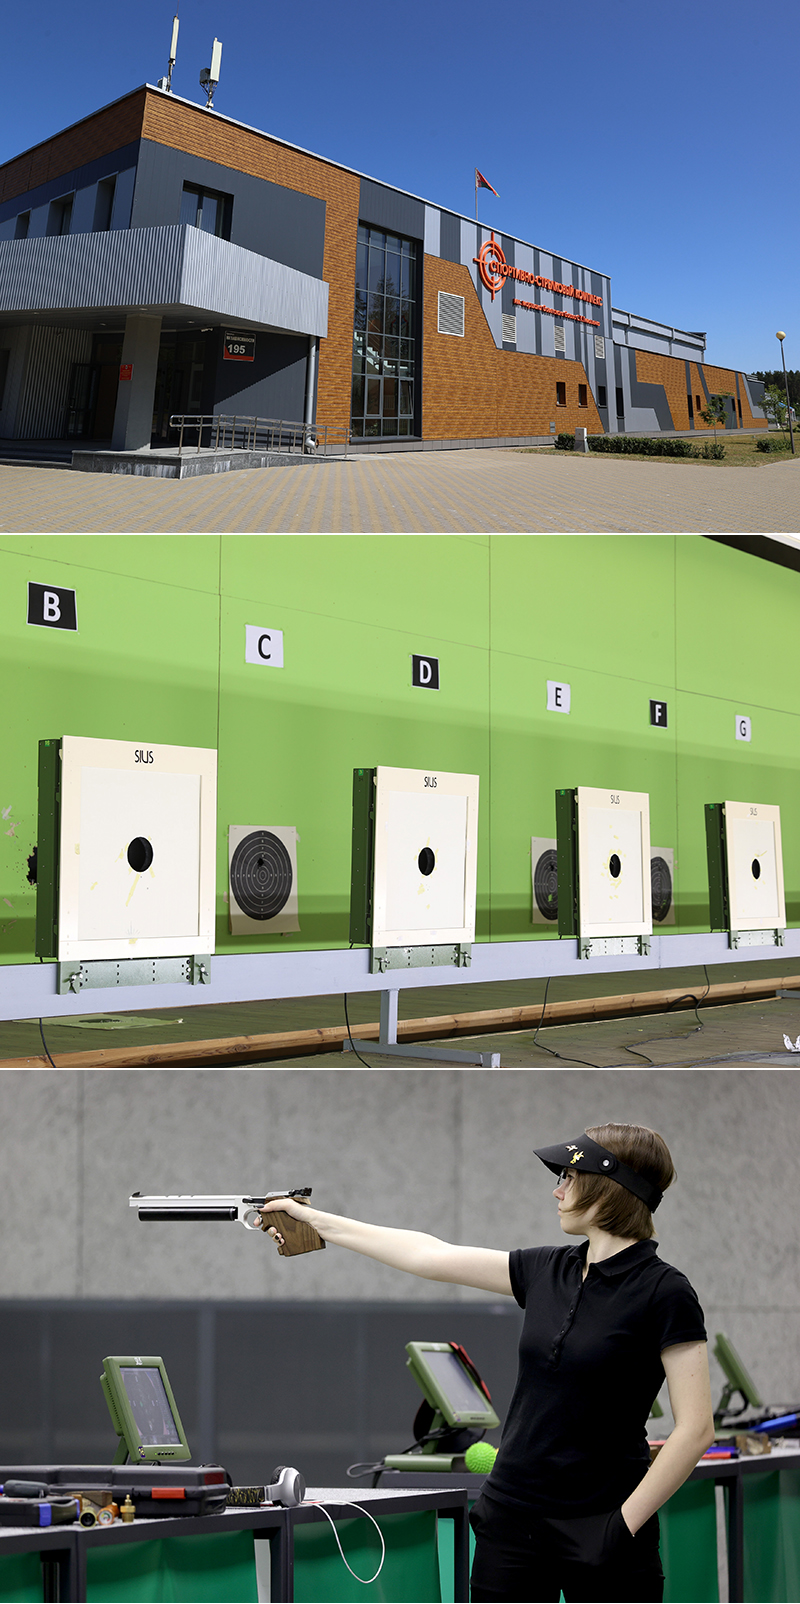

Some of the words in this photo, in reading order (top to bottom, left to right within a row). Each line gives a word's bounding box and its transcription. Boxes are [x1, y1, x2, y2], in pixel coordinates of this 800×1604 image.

[228, 344, 245, 354] 195
[43, 591, 61, 622] B
[258, 634, 271, 660] C
[419, 660, 432, 684] D
[555, 687, 562, 707] E
[655, 704, 662, 723] F
[739, 720, 747, 737] G
[134, 749, 154, 764] SIUS
[423, 776, 438, 788] SIUS
